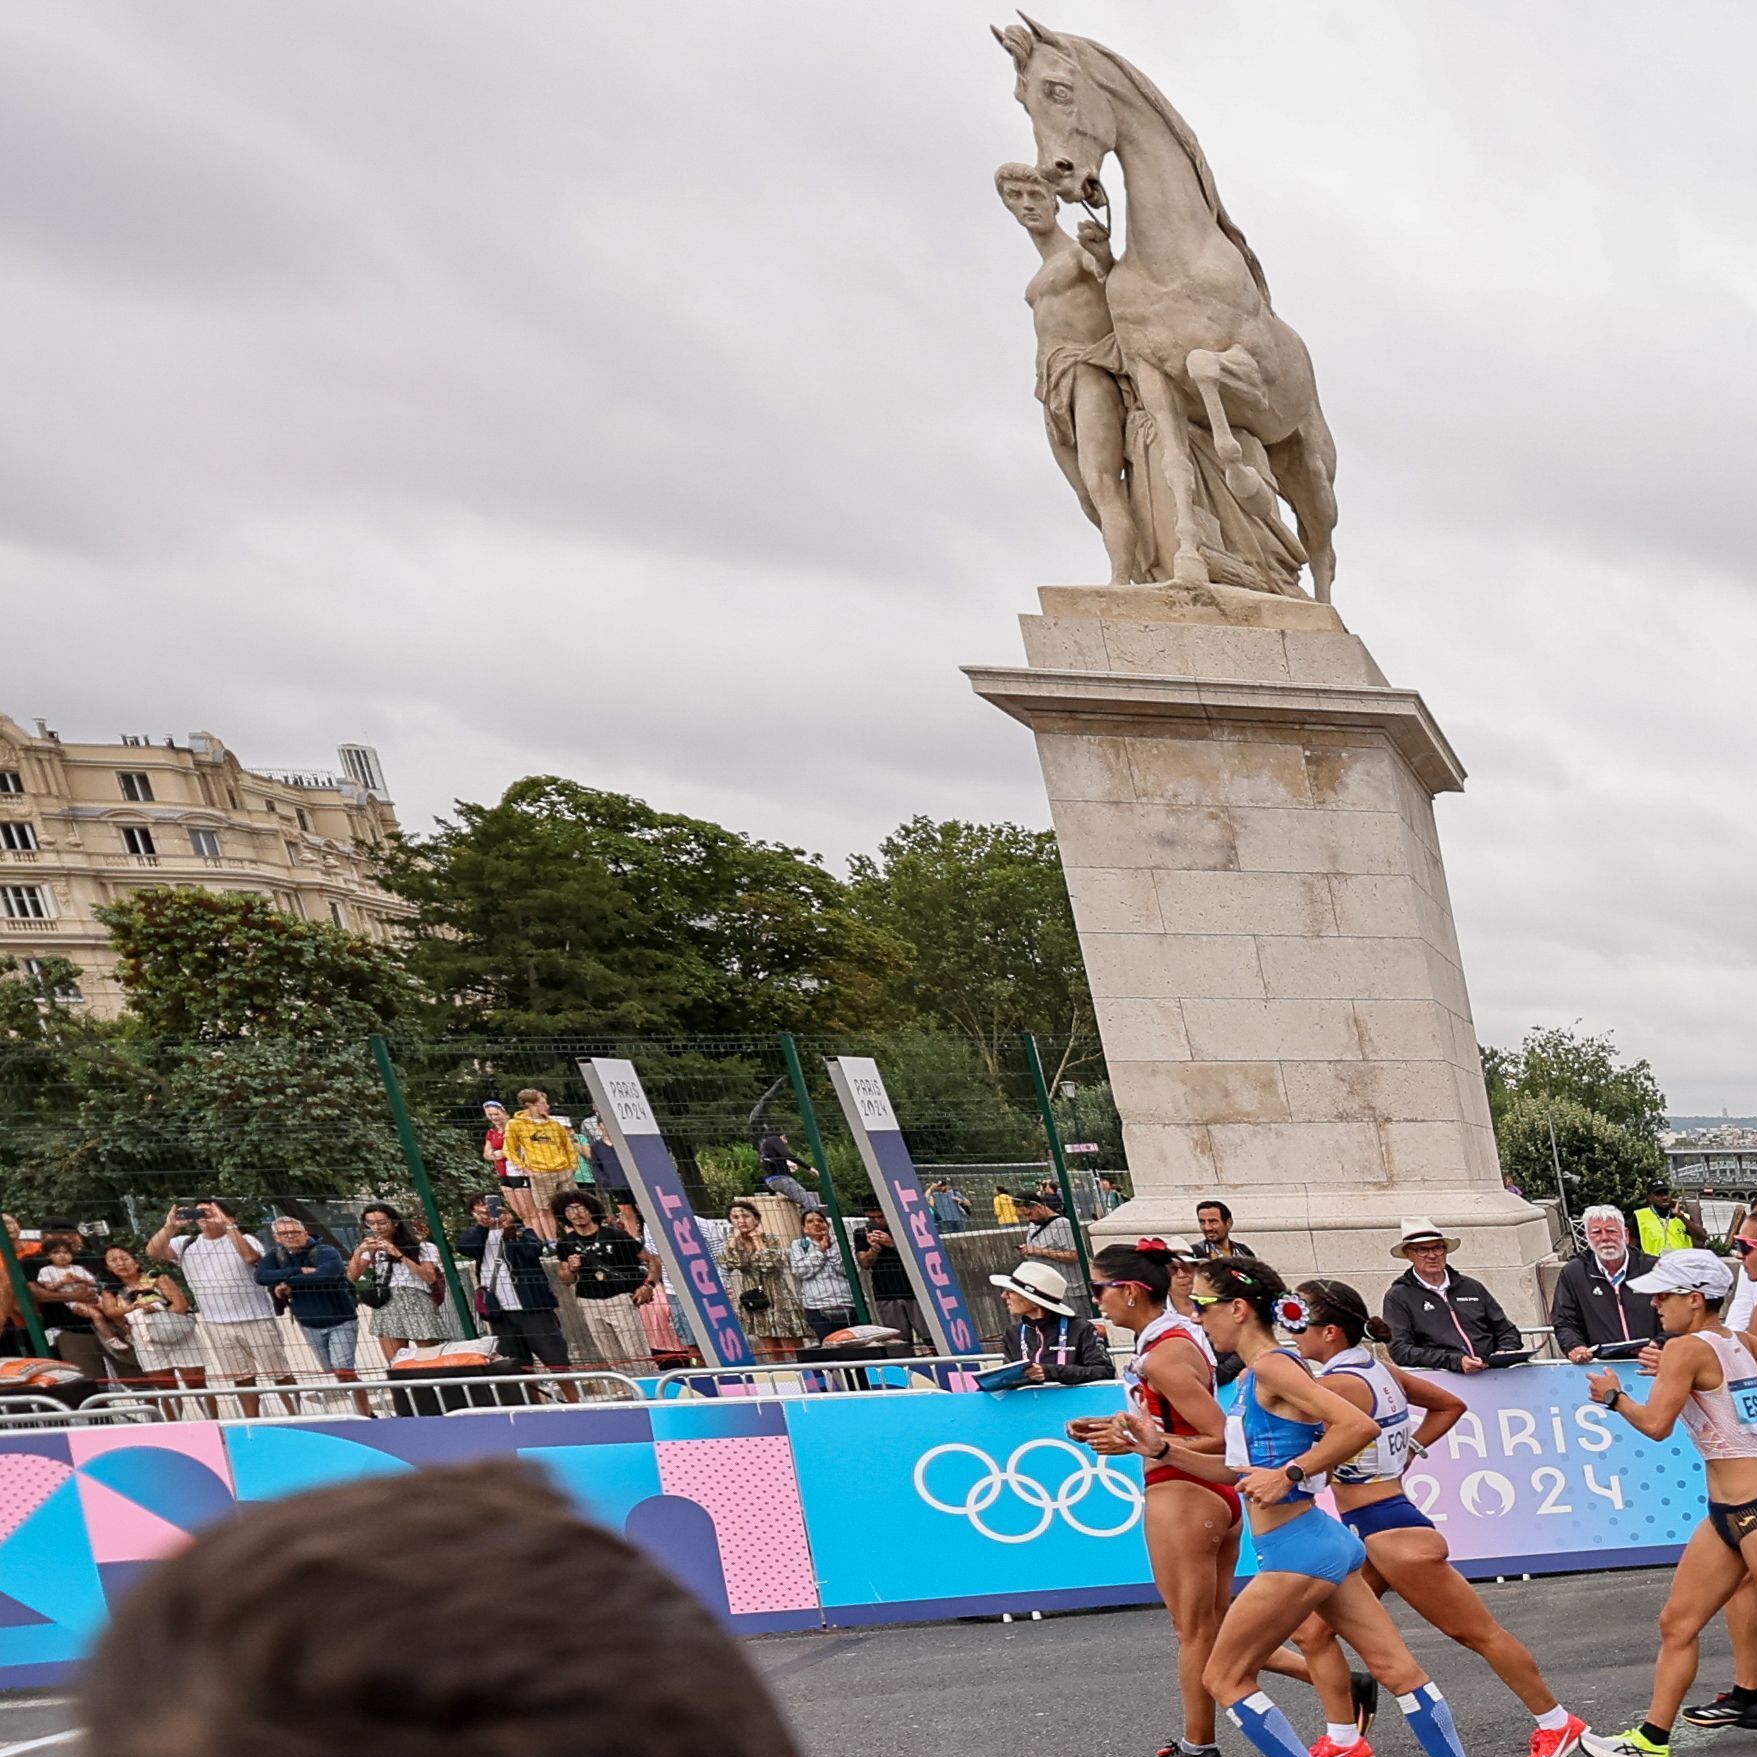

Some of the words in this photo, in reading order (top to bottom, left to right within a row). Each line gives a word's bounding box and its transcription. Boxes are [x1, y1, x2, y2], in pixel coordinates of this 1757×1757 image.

[617, 1102, 648, 1120] 2024
[861, 1099, 888, 1117] 2024
[655, 1185, 743, 1362] START
[894, 1179, 972, 1352] START
[1405, 1464, 1624, 1522] 2024
